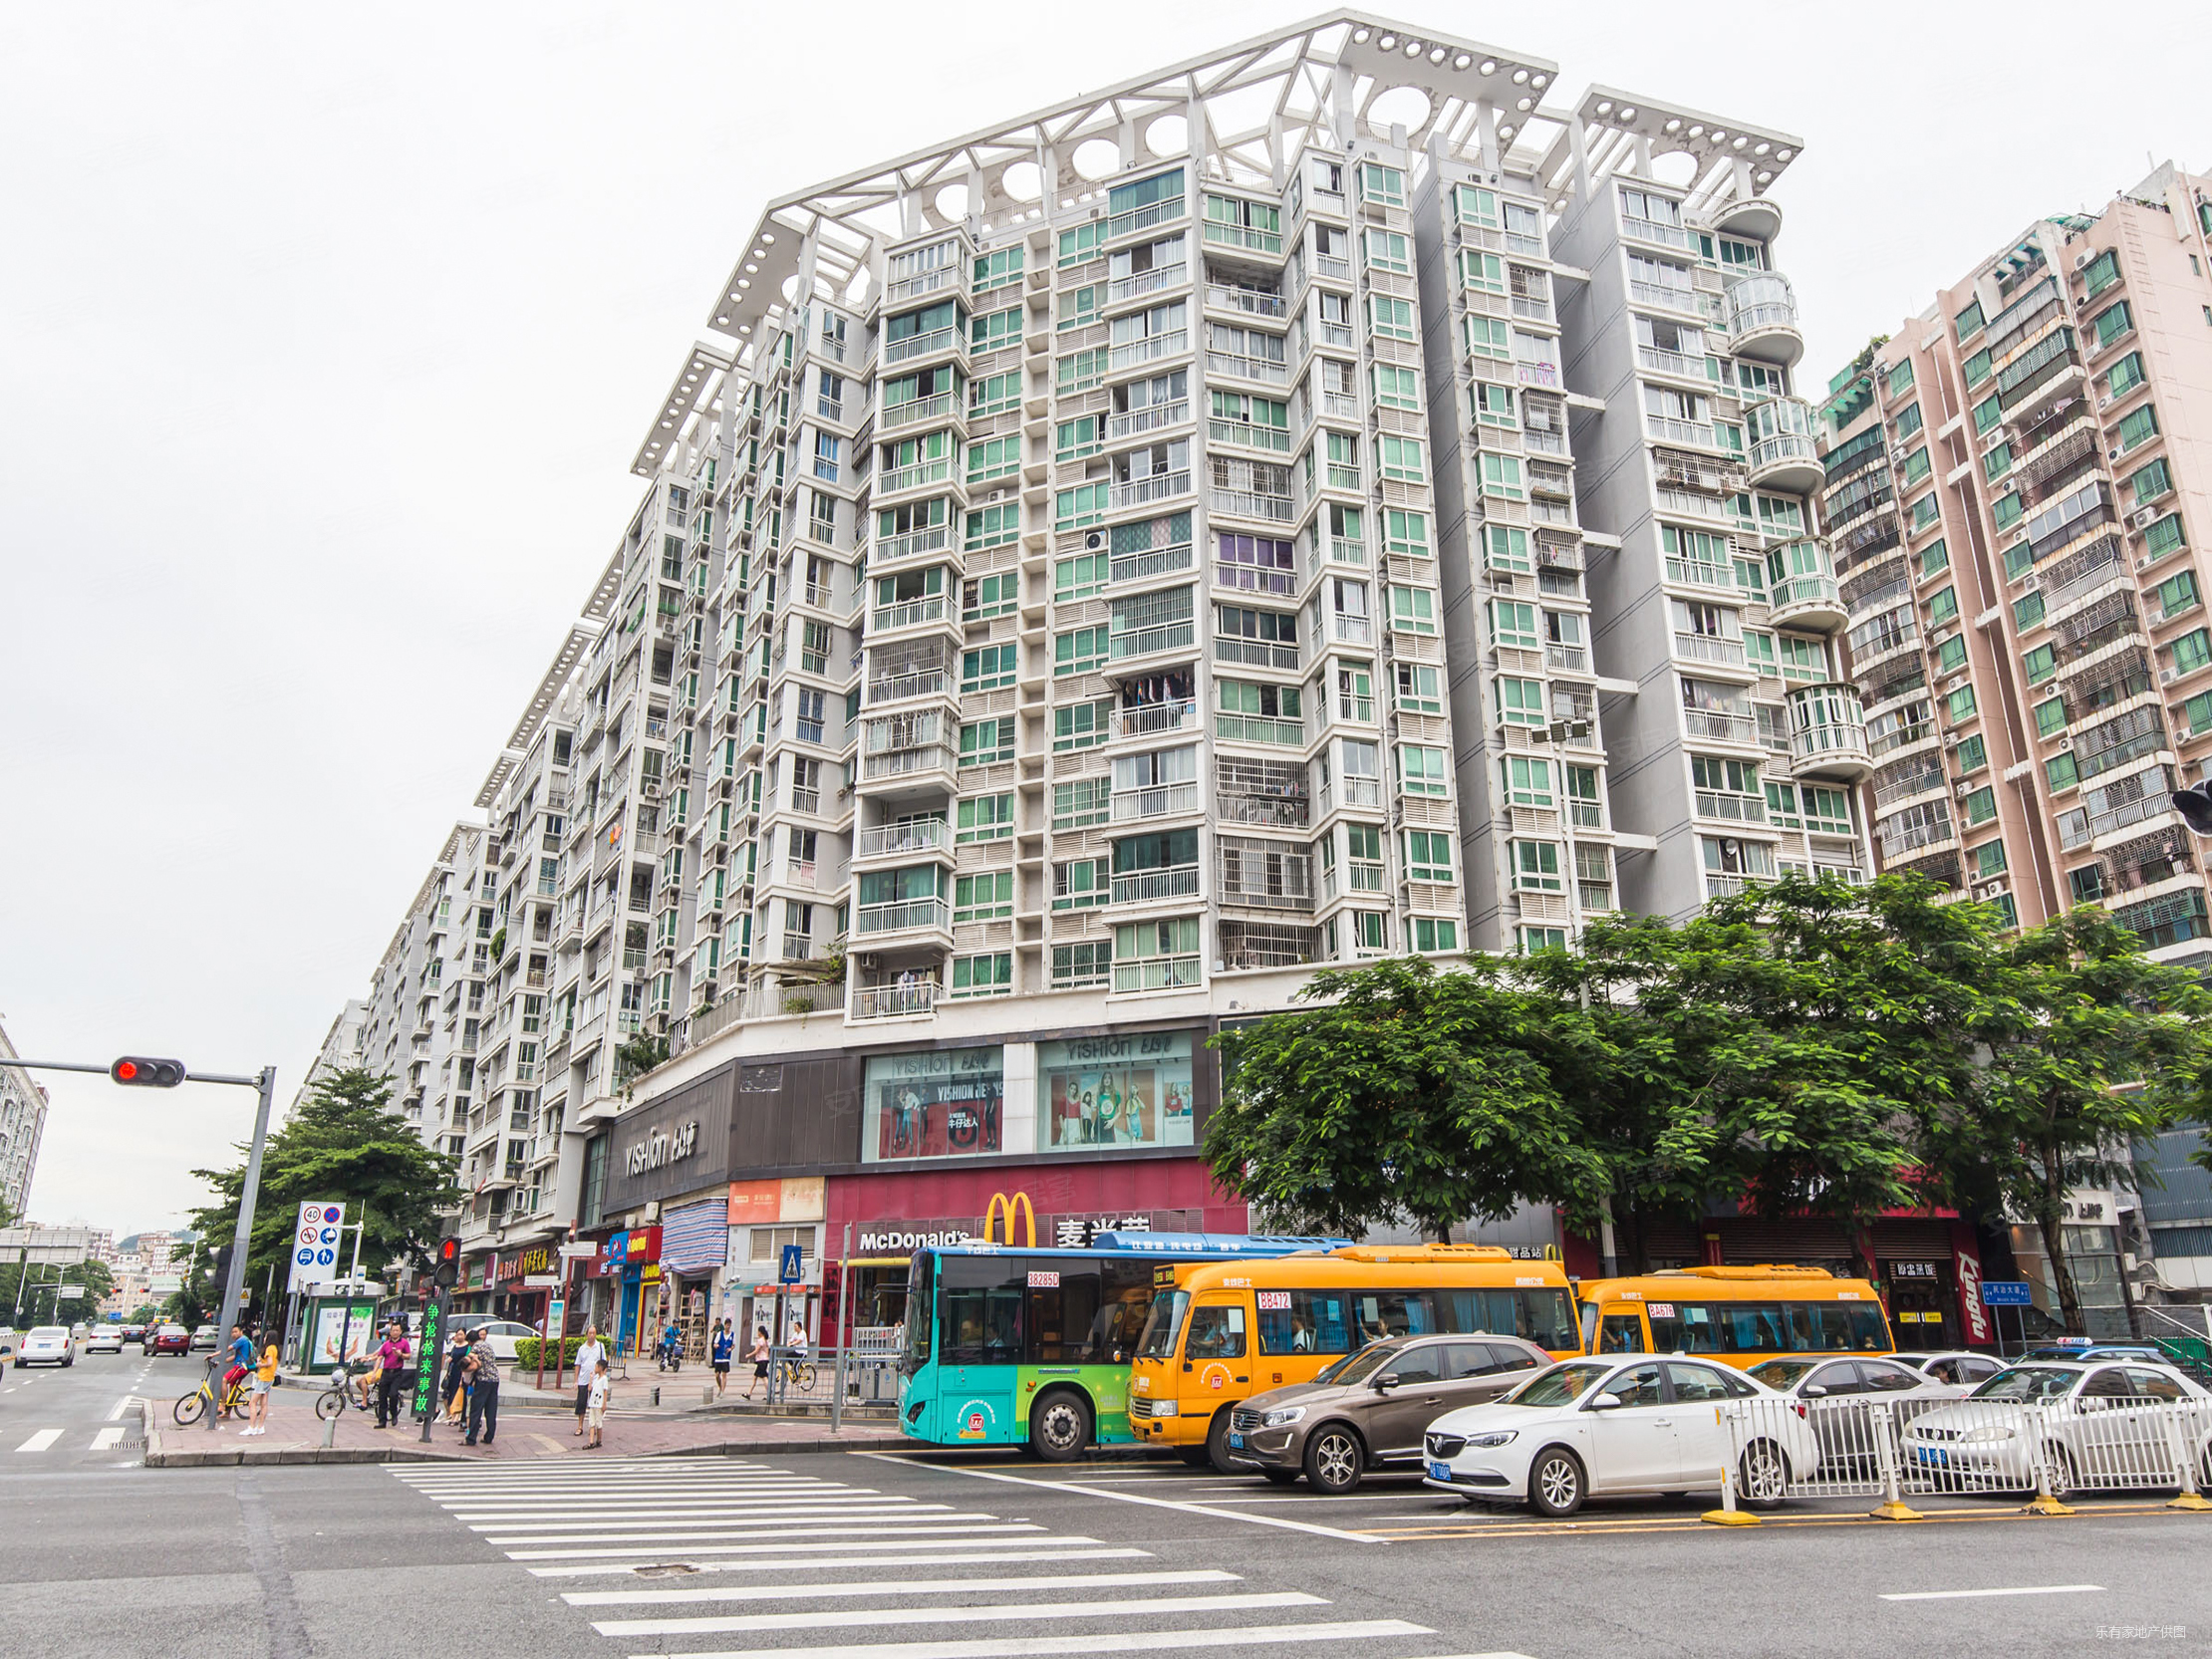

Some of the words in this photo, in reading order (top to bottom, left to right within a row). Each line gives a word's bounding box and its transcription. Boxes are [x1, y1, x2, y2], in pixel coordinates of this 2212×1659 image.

[938, 1083, 973, 1101] YISHION
[949, 1117, 978, 1129] 牛仔达人
[859, 1230, 970, 1251] McDonald's
[1028, 1273, 1060, 1285] 38285D
[1260, 1292, 1288, 1308] BB472
[1958, 1250, 1987, 1340] Kungfu
[1649, 1304, 1675, 1318] BA676
[415, 1303, 439, 1413] 争抢抢来事故
